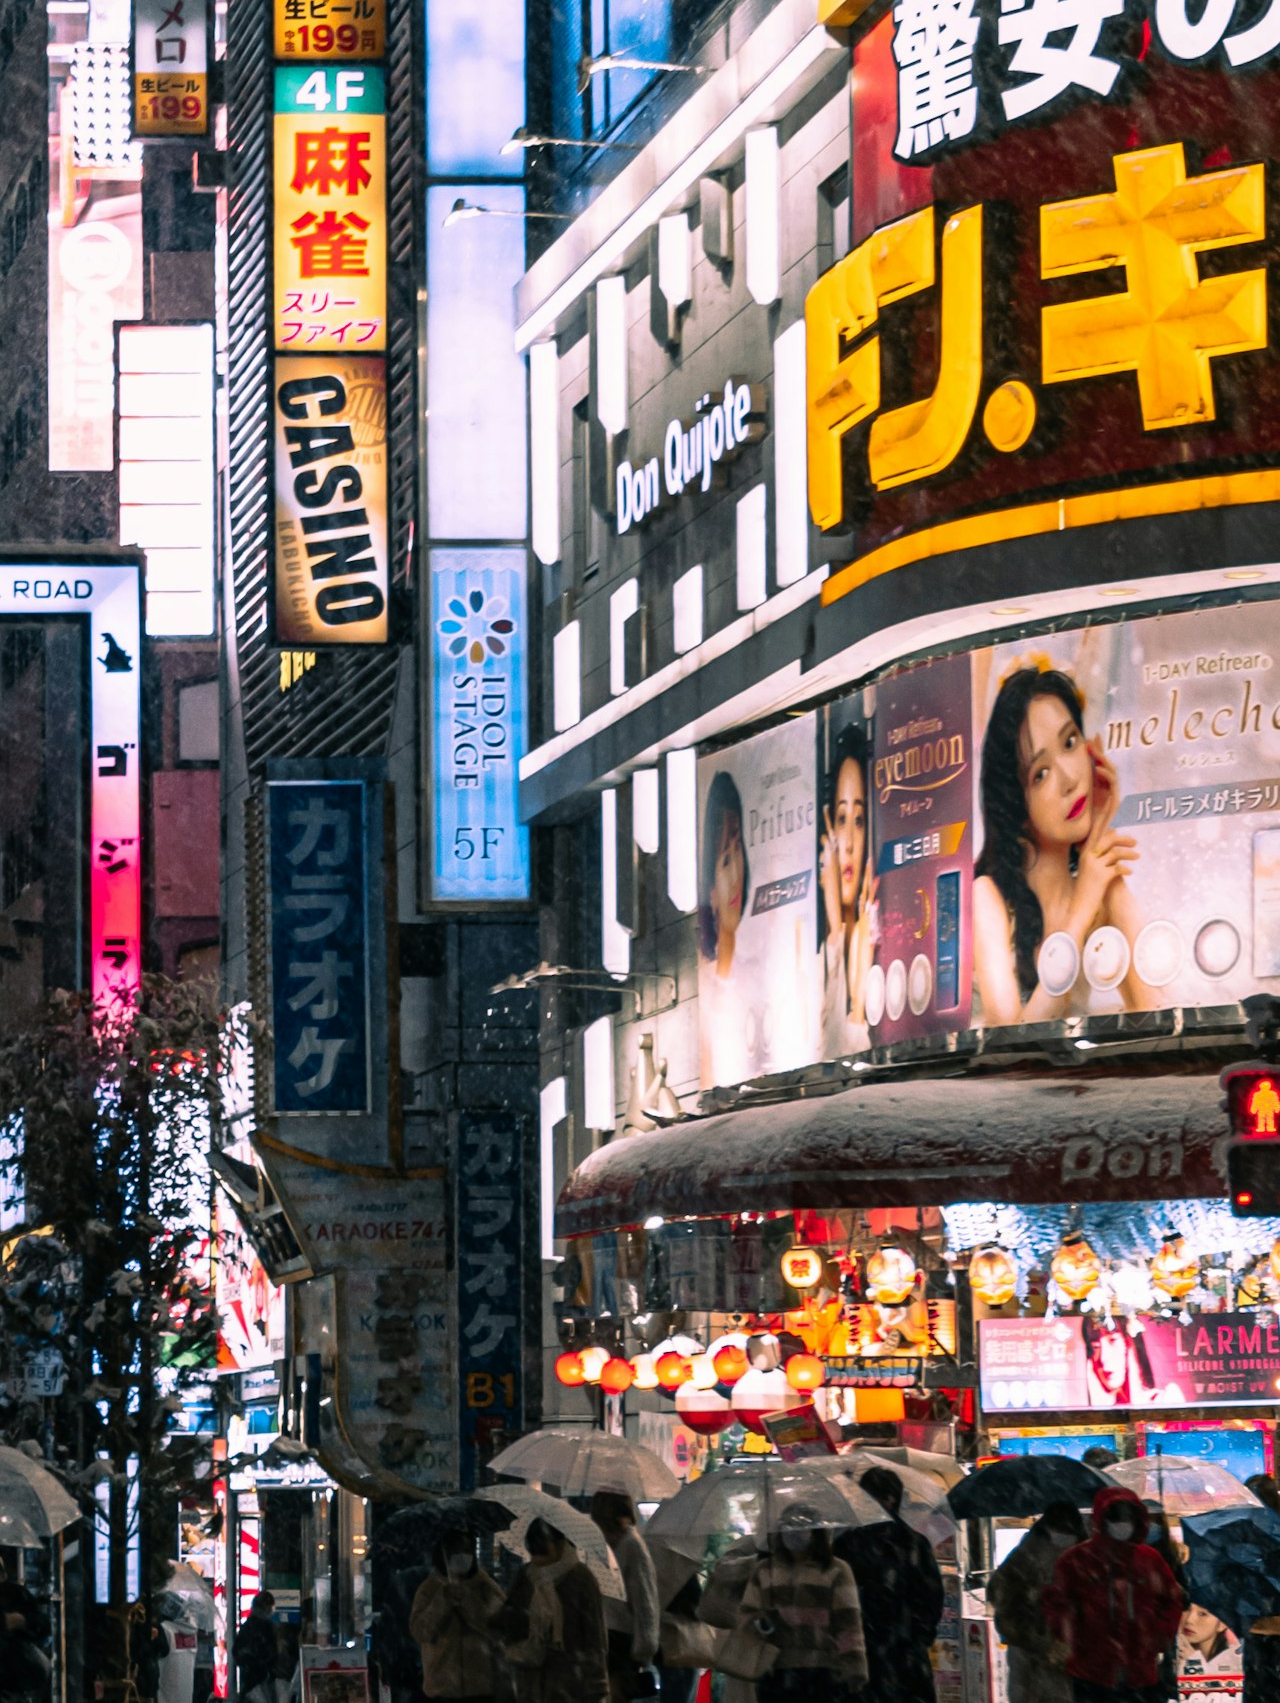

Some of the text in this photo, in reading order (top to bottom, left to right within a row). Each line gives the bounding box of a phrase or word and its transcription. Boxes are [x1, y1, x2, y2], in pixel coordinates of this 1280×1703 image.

[285, 0, 375, 20] 生ビール
[299, 24, 360, 53] 199
[141, 77, 201, 94] 生ビール
[295, 71, 366, 109] 4F
[290, 129, 371, 280] 麻雀
[281, 292, 356, 315] スリー
[281, 318, 379, 346] ファイブ
[616, 380, 751, 534] Don Quijote
[277, 375, 386, 626] CASINO
[14, 579, 94, 599] ROAD
[277, 520, 314, 635] KABUKICHO
[454, 676, 478, 790] STAGE
[483, 676, 505, 770] IDOL
[875, 734, 965, 805] eyemoon
[454, 826, 505, 860] 5F
[749, 795, 815, 848] Prifuse
[96, 742, 137, 969] ゴジラ
[287, 795, 354, 1094] カラオケ
[464, 1124, 516, 1360] カラオケ
[464, 1372, 516, 1408] B1
